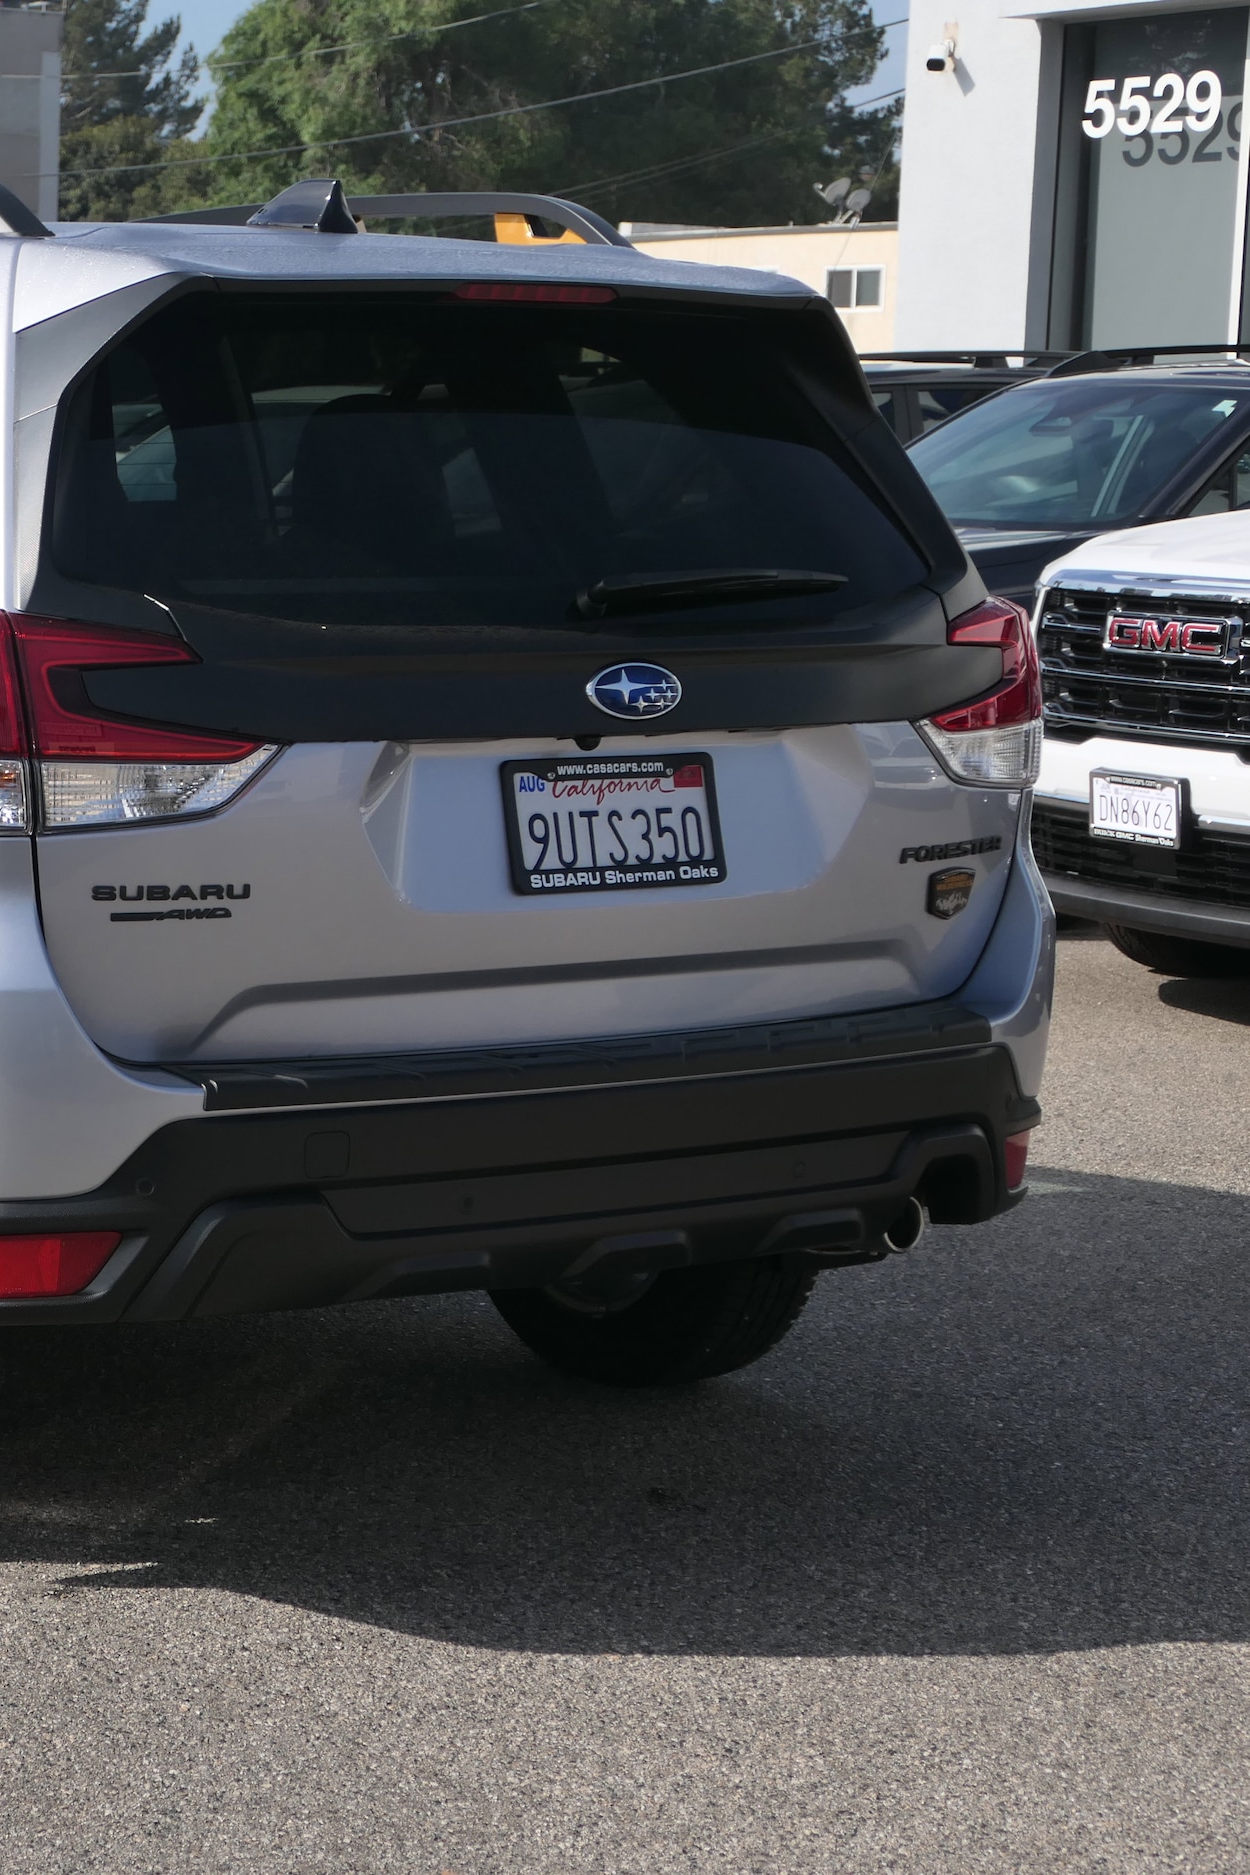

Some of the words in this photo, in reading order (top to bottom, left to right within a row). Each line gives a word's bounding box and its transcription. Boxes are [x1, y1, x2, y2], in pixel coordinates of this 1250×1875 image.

[1082, 69, 1222, 139] 5529
[1108, 616, 1221, 656] GMC
[556, 761, 664, 776] www.casacars.com
[519, 775, 546, 793] AUG
[552, 776, 676, 805] California
[1099, 794, 1173, 832] DN86Y62
[528, 806, 706, 870] 9UTS350
[899, 835, 1002, 864] FORESTER
[530, 871, 601, 888] SUBARU
[605, 868, 676, 885] Sherman
[679, 865, 719, 878] Oaks
[91, 883, 251, 901] SUBARU
[155, 907, 232, 921] AWD
